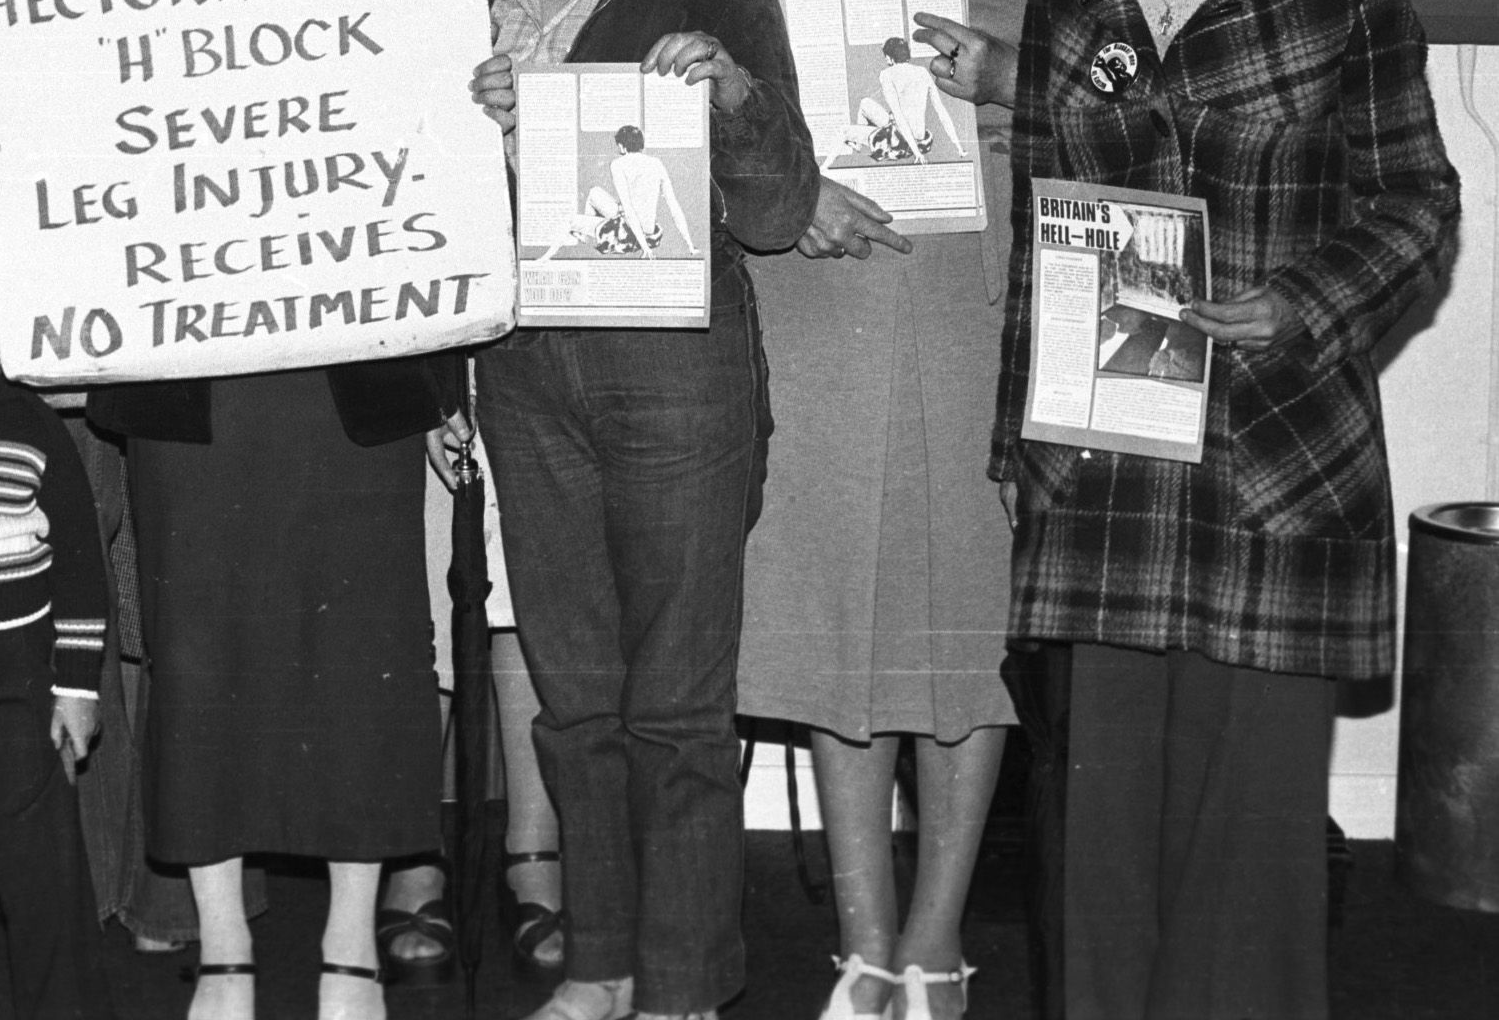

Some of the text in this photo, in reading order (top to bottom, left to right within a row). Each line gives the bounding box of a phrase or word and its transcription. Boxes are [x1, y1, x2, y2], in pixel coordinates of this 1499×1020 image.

[97, 12, 385, 84] "H" BLOCK
[114, 89, 358, 155] SEVERE
[35, 178, 139, 230] LEG
[1040, 197, 1111, 224] BRITAIN'S
[125, 212, 448, 288] RECEIVES
[30, 272, 493, 361] NO TREATMENT
